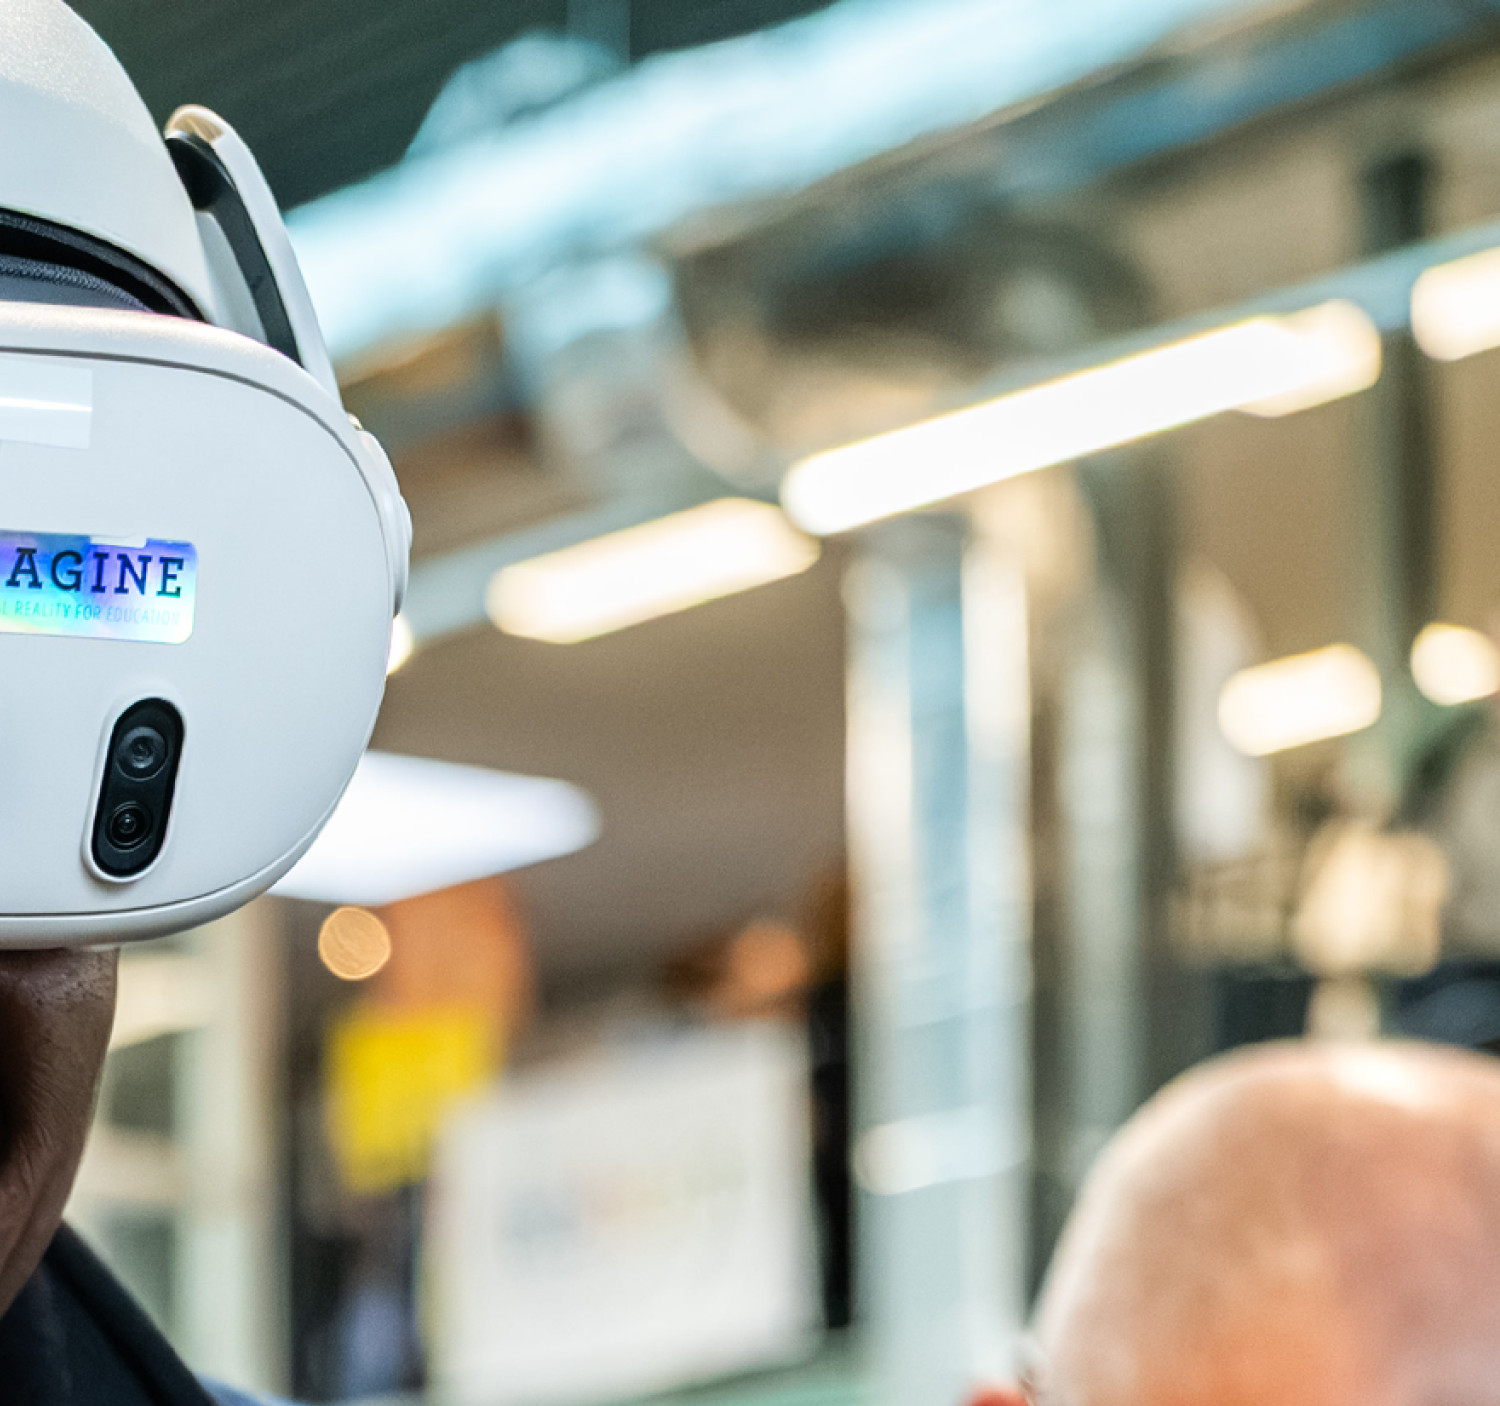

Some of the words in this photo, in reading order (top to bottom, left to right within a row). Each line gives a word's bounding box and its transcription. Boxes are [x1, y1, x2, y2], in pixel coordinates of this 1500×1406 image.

[14, 599, 72, 619] REALITY
[75, 602, 101, 621] FOR
[106, 606, 180, 627] EDUCATION
